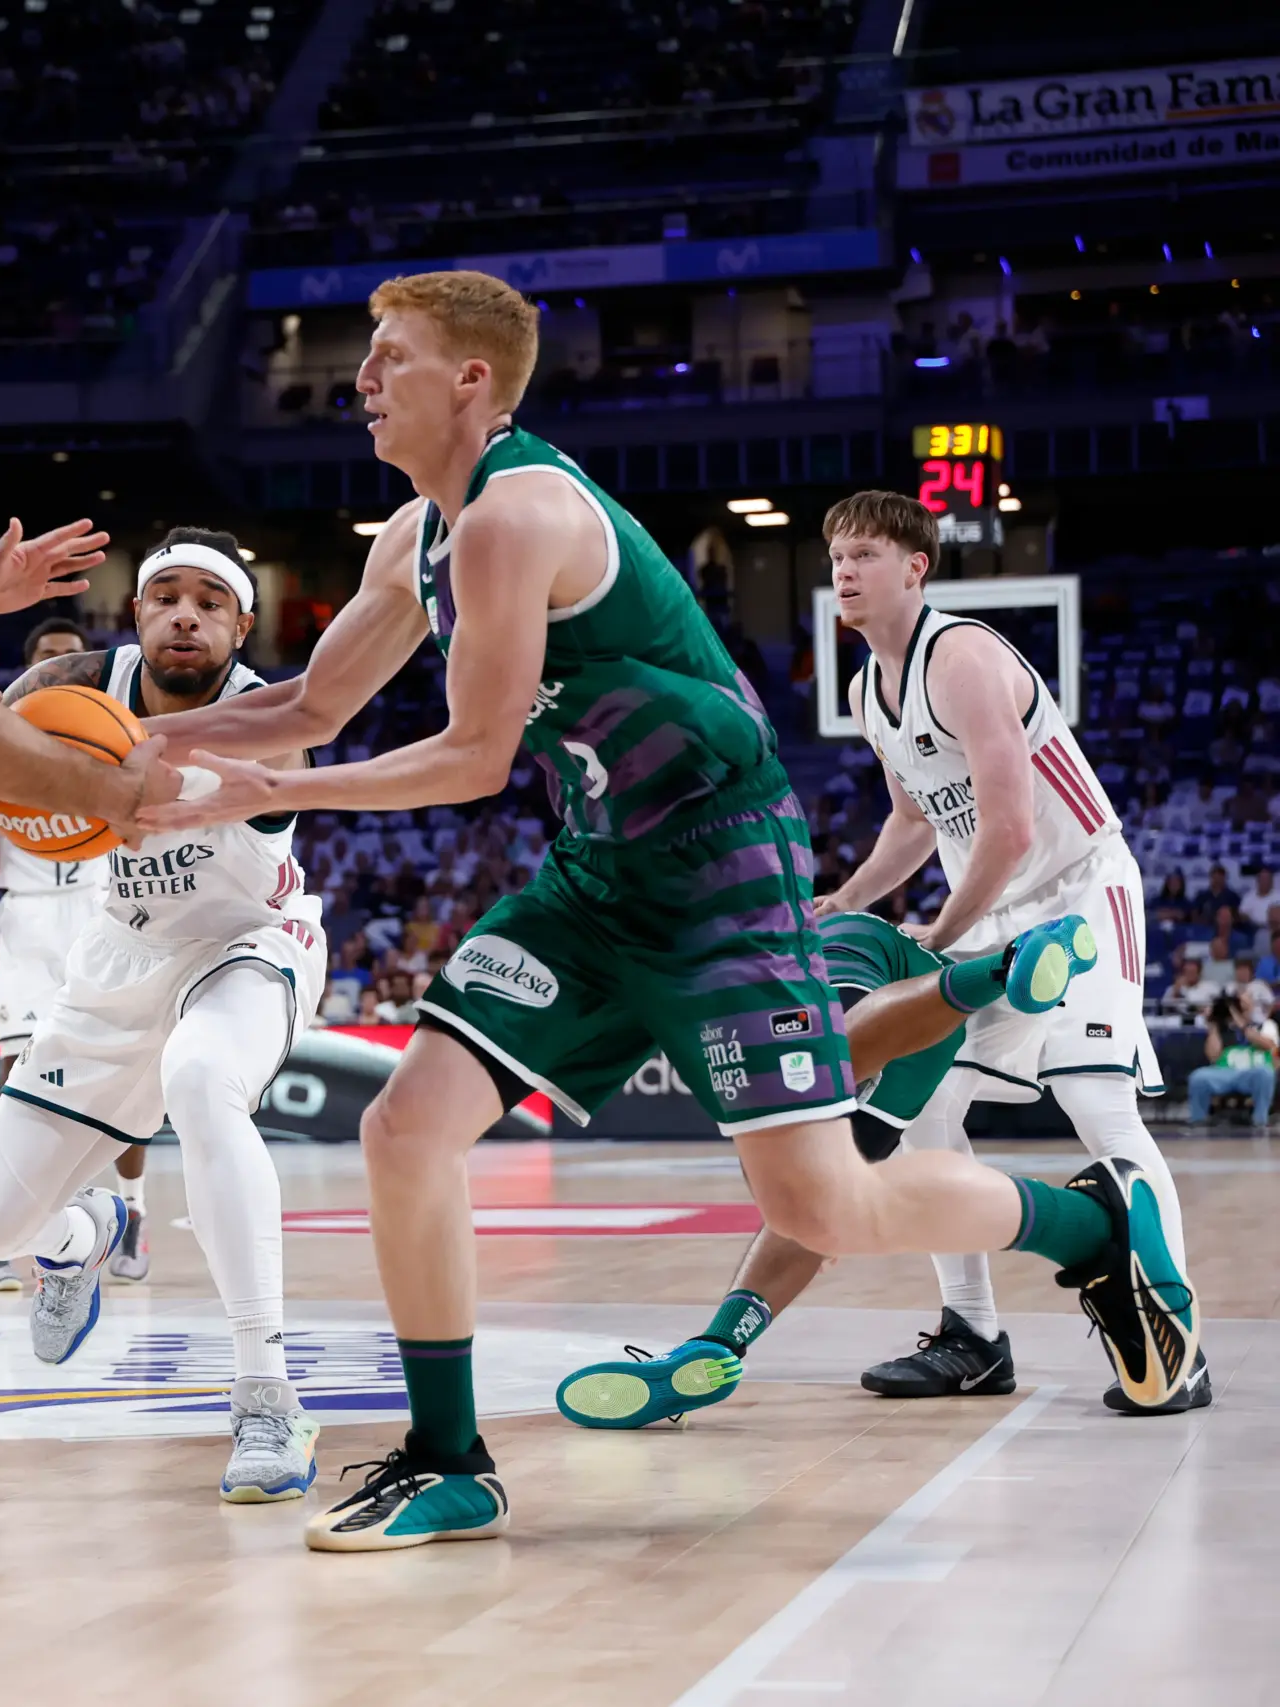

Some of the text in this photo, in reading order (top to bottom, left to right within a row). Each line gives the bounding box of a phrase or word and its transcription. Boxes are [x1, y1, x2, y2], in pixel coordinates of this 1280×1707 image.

[968, 88, 1024, 127] La
[1032, 83, 1157, 121] Gran
[1167, 72, 1280, 109] Fam
[1006, 136, 1176, 171] Comunidad
[1187, 136, 1224, 156] de
[920, 460, 985, 513] 24
[107, 843, 215, 878] irates
[117, 873, 196, 899] BETTER
[458, 948, 553, 998] amadesa
[700, 1023, 724, 1042] sabor
[775, 1020, 803, 1034] acb
[1088, 1029, 1108, 1037] acb
[708, 1029, 746, 1067] má
[707, 1063, 751, 1100] laga
